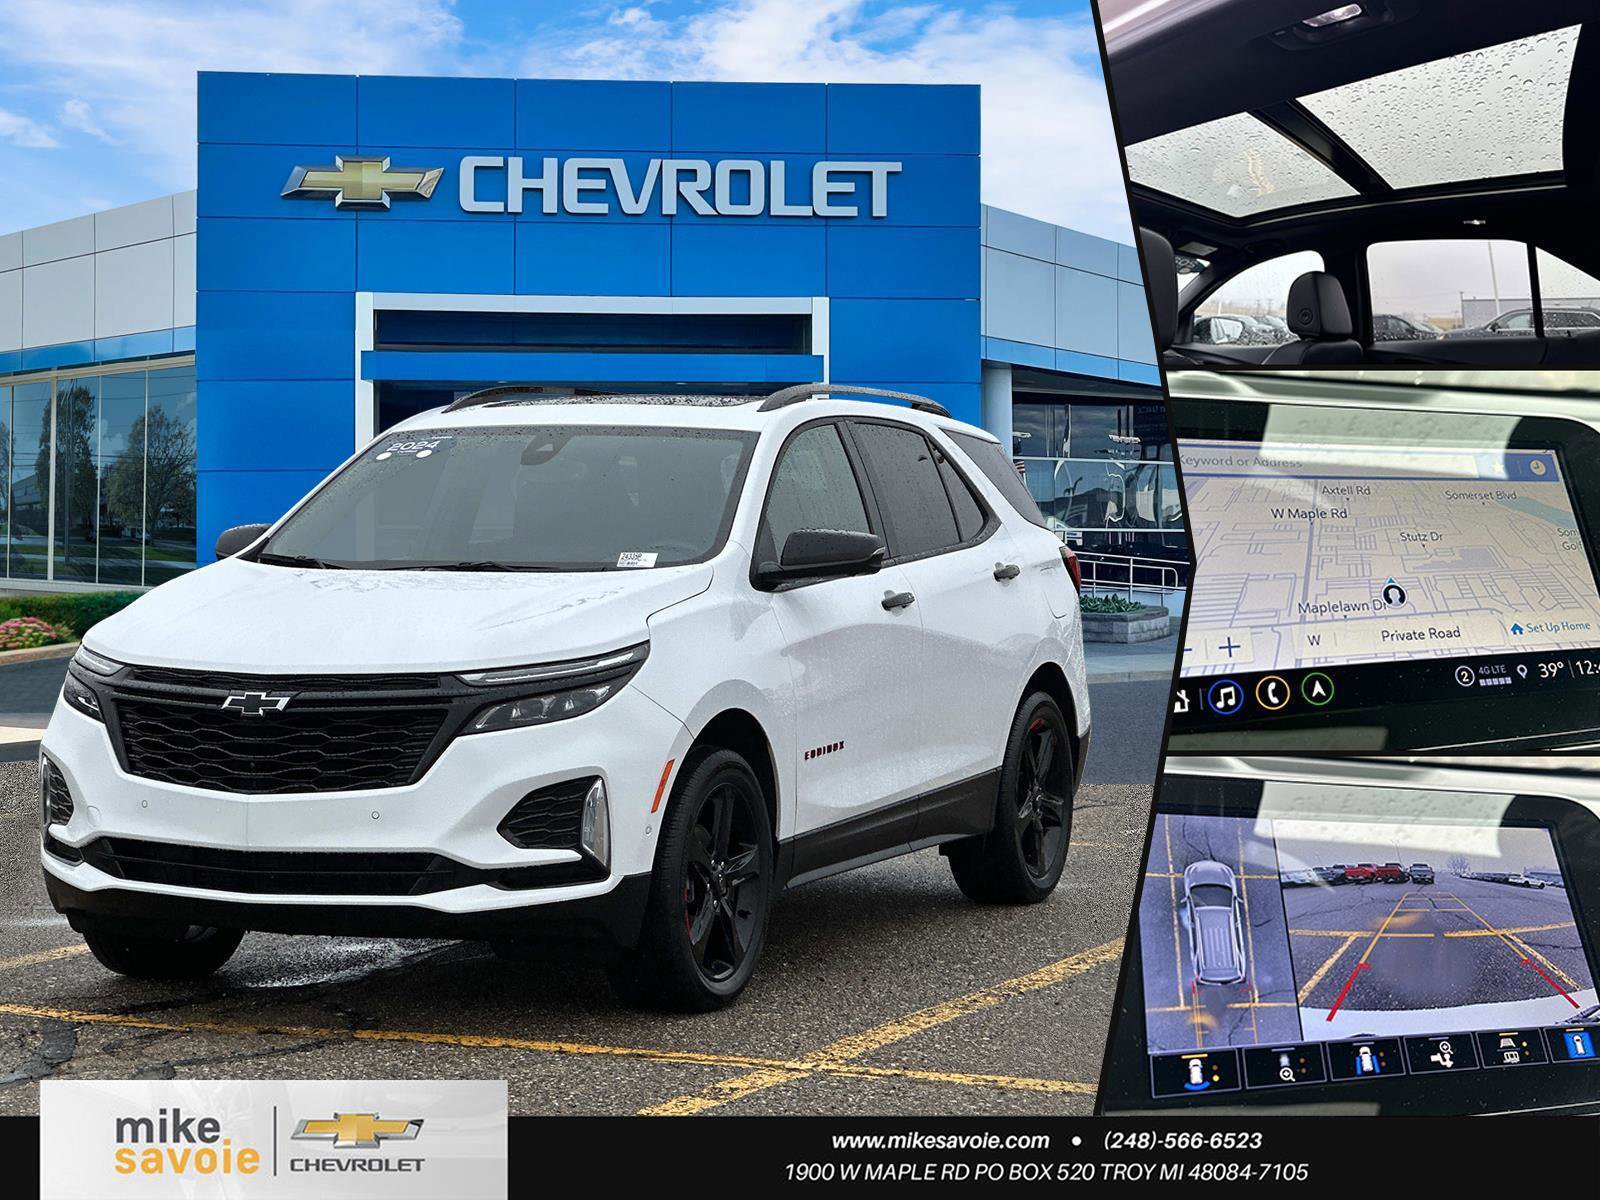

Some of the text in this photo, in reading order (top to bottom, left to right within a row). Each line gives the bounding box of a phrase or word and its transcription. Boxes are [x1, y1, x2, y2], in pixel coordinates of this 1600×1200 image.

[459, 156, 902, 217] CHEVROLET
[386, 440, 440, 452] 2024
[1236, 458, 1250, 467] or
[1253, 456, 1303, 468] Address
[1321, 485, 1371, 496] Axtell Rd
[1444, 490, 1517, 501] Somerset Blvd
[1270, 508, 1348, 522] W Maple Rd
[1400, 531, 1443, 542] Stutz Dr
[1298, 600, 1370, 616] Maplelawn
[1526, 621, 1591, 634] Set Up Home
[1381, 626, 1461, 642] Private Road
[1307, 635, 1321, 646] W
[1575, 660, 1600, 675] 12:
